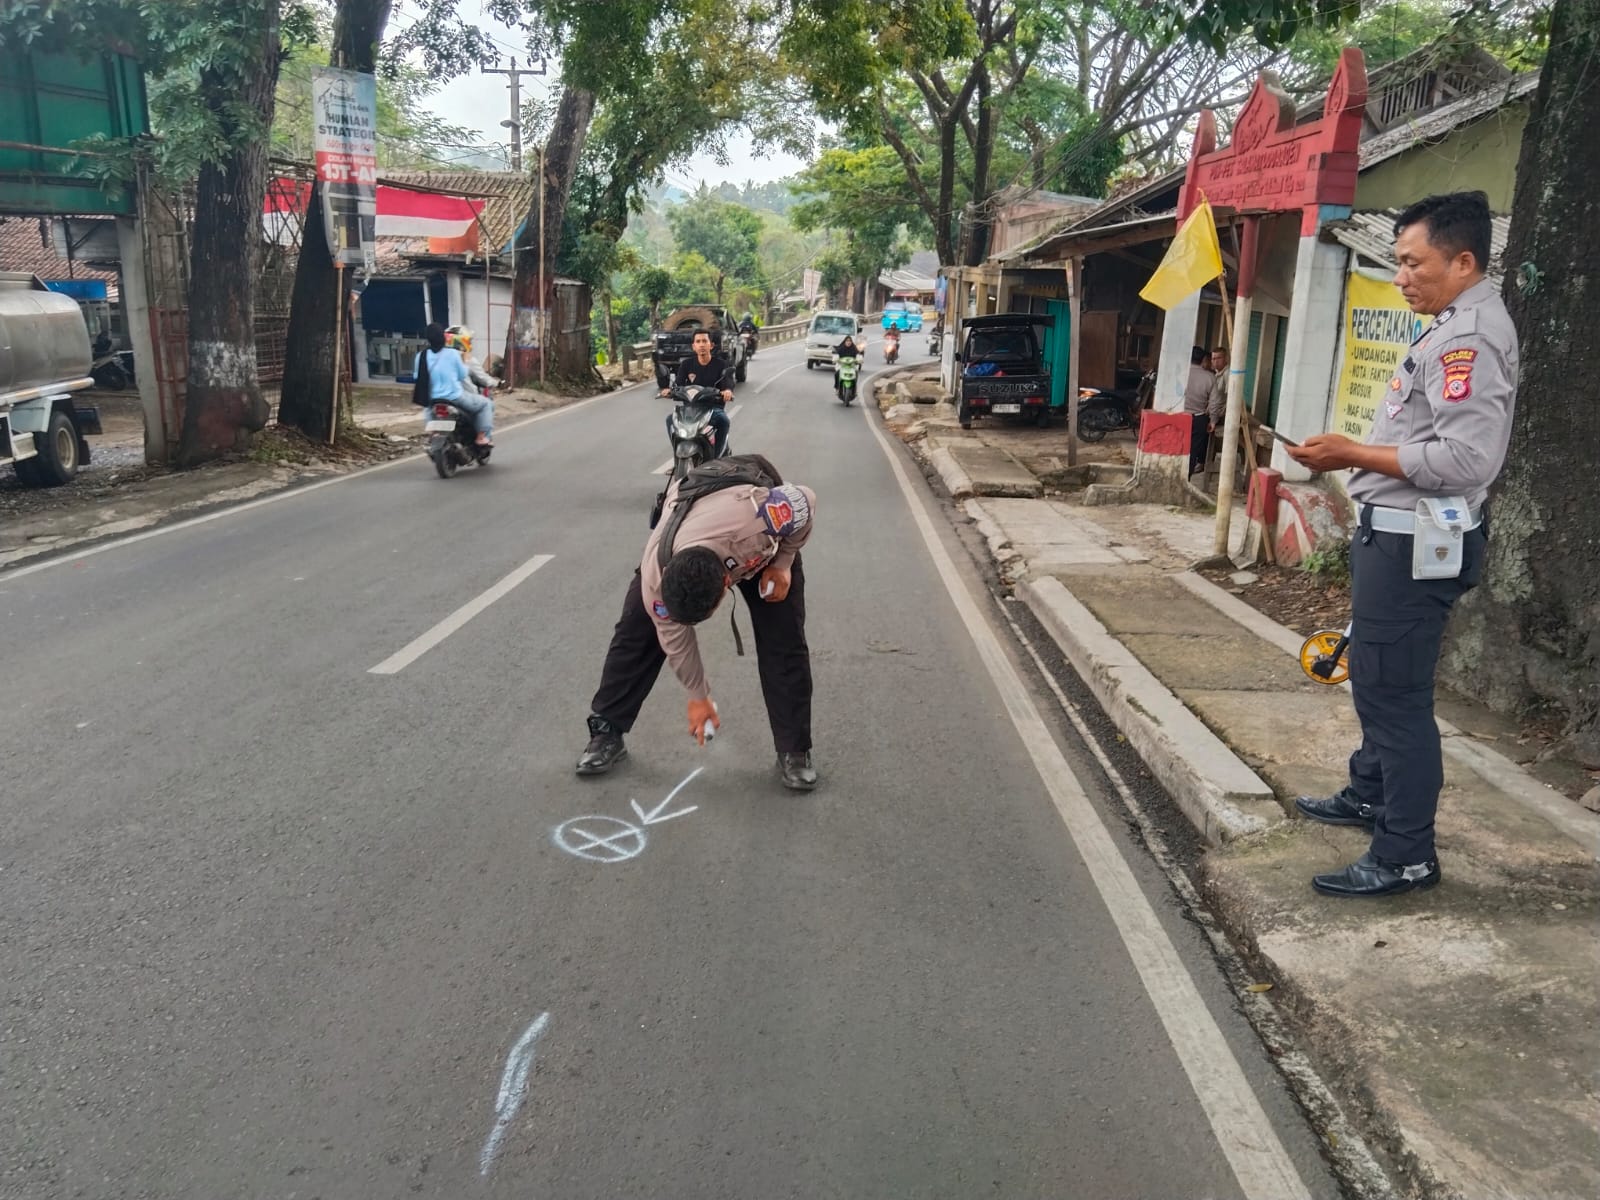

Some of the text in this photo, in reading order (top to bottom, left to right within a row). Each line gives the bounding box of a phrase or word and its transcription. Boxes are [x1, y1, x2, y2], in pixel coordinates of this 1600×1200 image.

[326, 112, 369, 127] HUNIAN
[1352, 308, 1415, 344] PERCETAKAN
[1353, 346, 1397, 364] UNDANGAN
[1351, 364, 1367, 379] NOTA
[980, 383, 1038, 394] SUZUKI
[1348, 381, 1372, 399] BROSUR
[1344, 420, 1363, 437] YASIN
